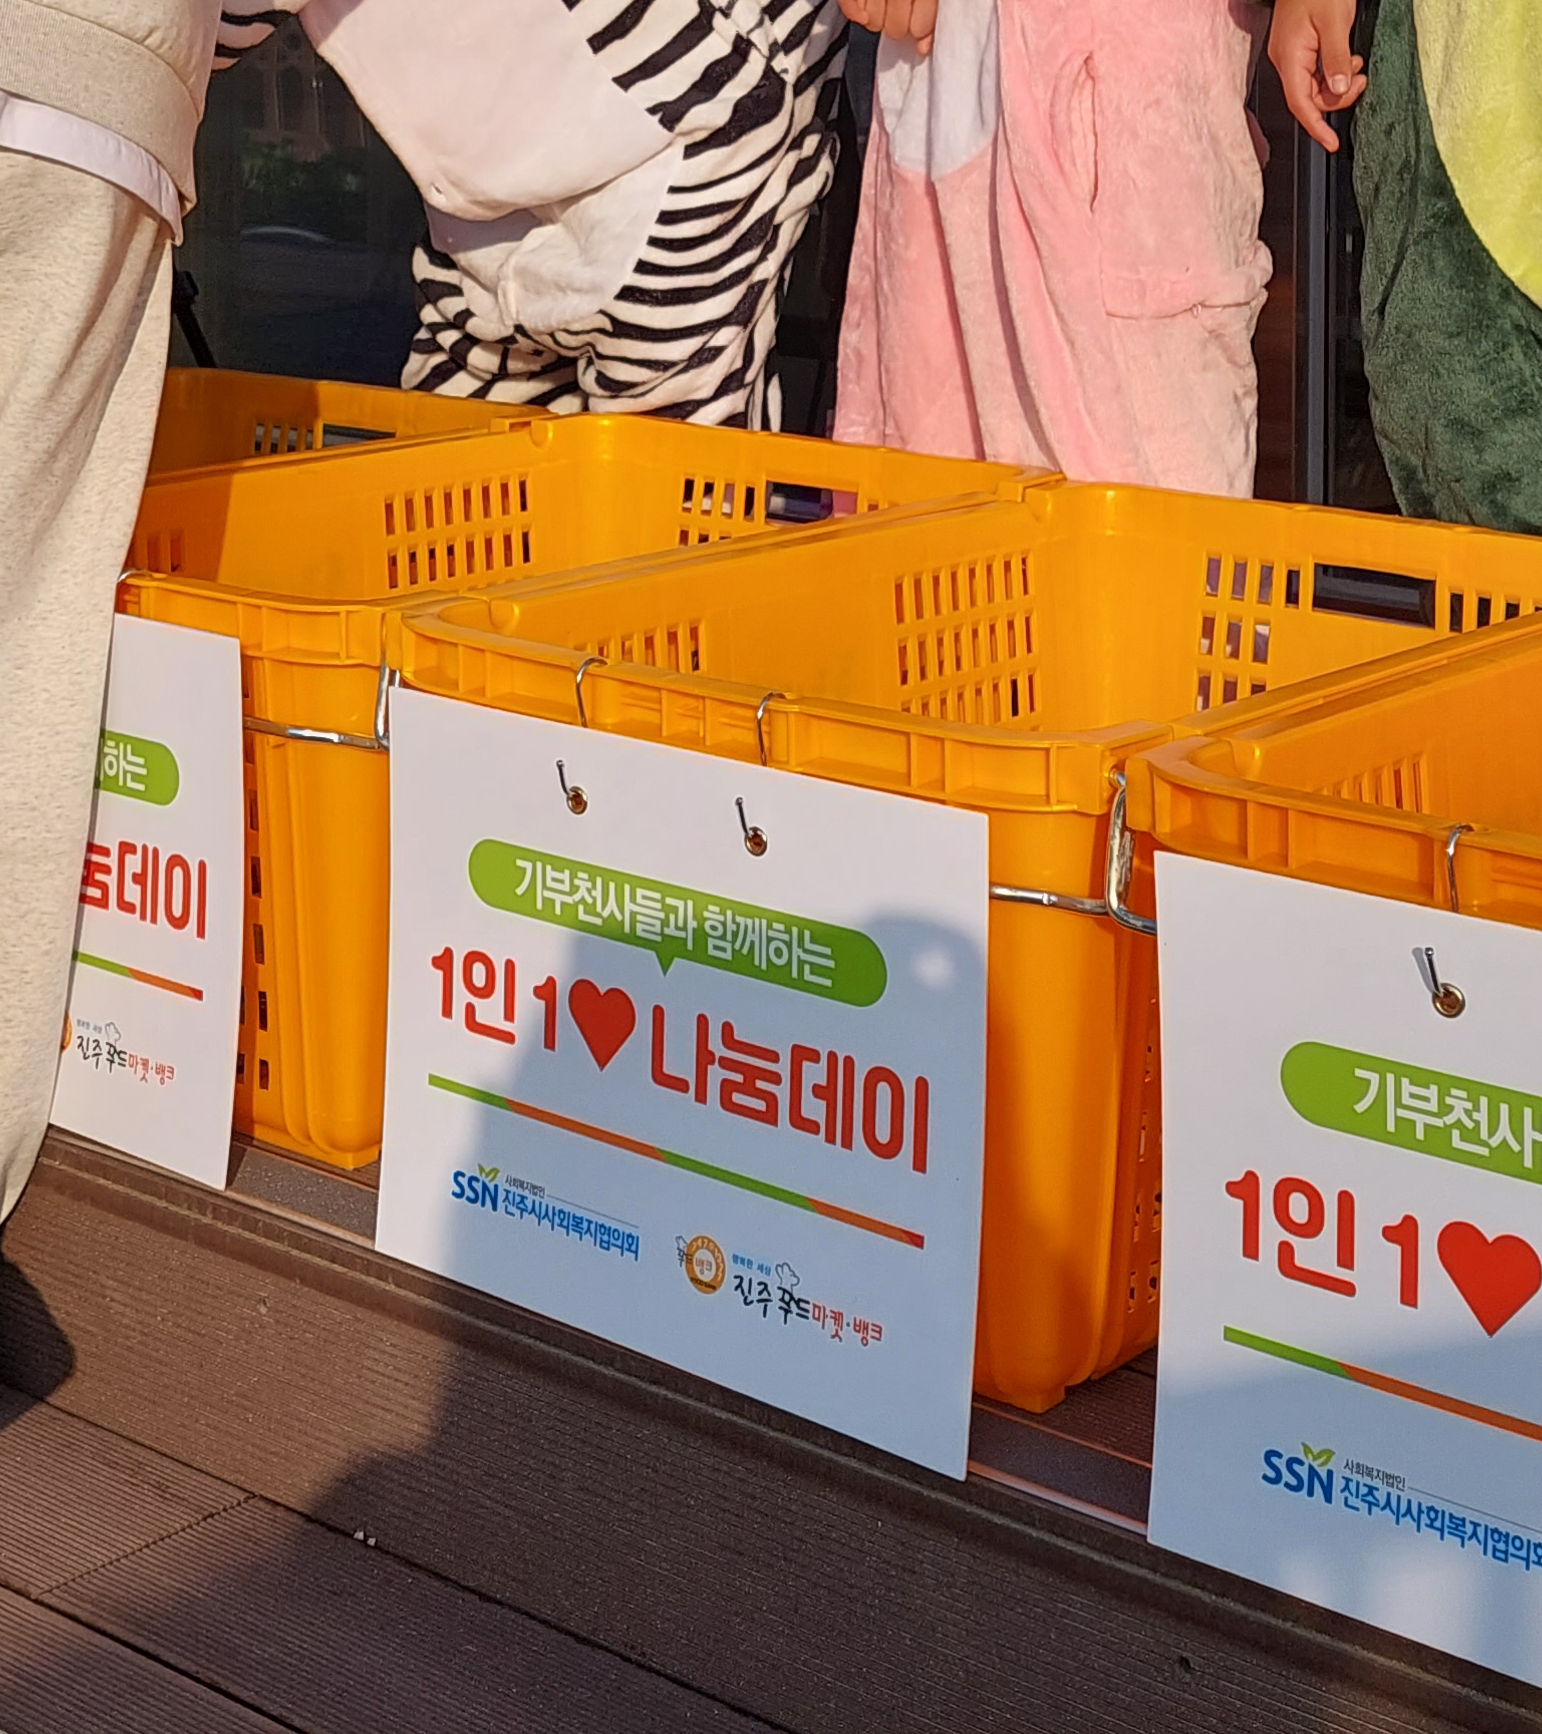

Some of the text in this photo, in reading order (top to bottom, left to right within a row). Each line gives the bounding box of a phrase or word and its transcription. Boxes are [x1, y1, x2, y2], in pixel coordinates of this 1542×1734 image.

[100, 738, 148, 792] 하는
[514, 858, 835, 987] 기부천사들과 함께하는
[430, 946, 516, 1045] 1인
[650, 1004, 929, 1174] 나눔데이
[451, 1170, 499, 1212] SSN
[504, 1174, 546, 1198] 사회복지법인
[502, 1187, 640, 1262] 진주시사회복지협의회
[1225, 1169, 1357, 1297] 1인
[733, 1275, 773, 1318] 진주
[1261, 1449, 1333, 1504] SSN
[1343, 1458, 1406, 1492] 사회복지법인
